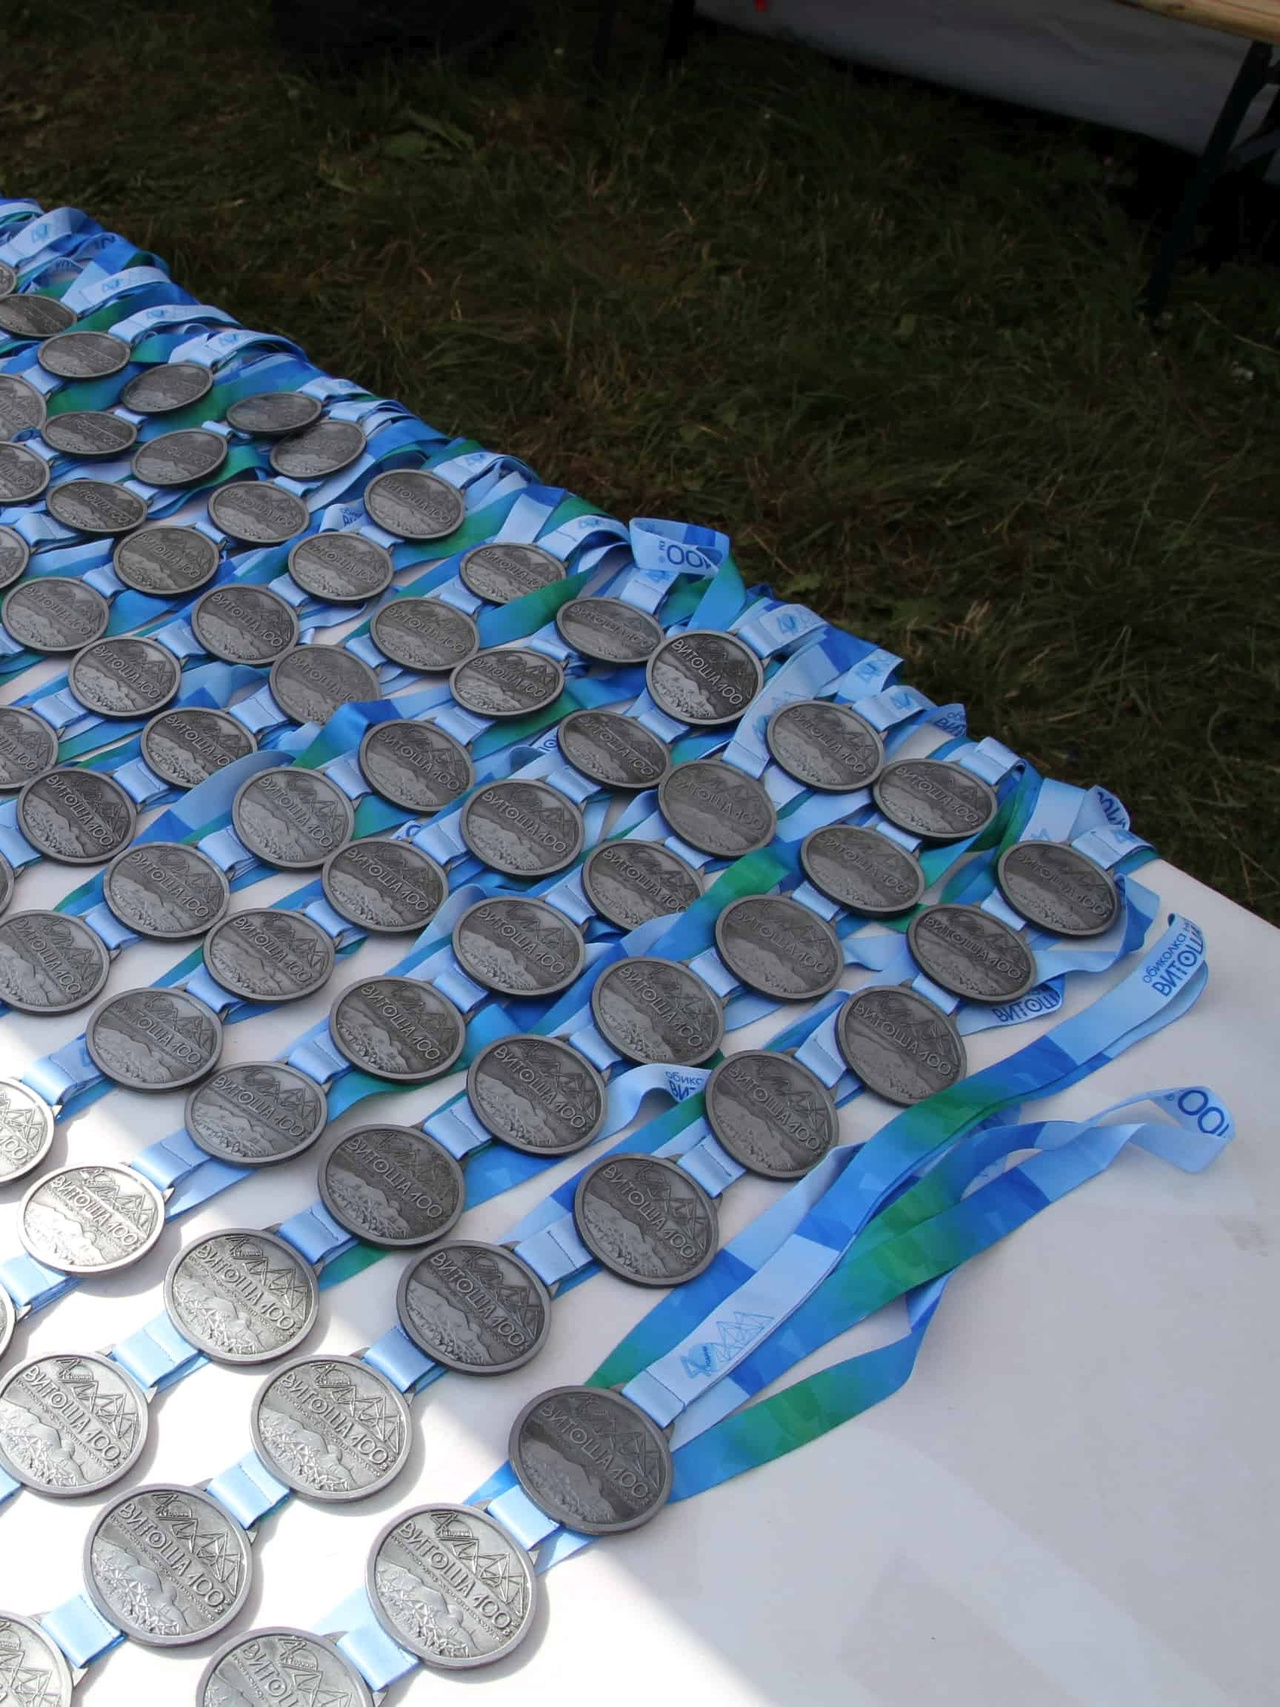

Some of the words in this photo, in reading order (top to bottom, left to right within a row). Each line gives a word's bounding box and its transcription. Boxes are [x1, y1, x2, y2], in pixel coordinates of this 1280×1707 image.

[669, 639, 721, 689] ВИТОША
[716, 684, 741, 704] 100
[165, 715, 212, 756] ВИТОША
[379, 728, 432, 772] ВИТОША
[47, 775, 93, 826] ВИТОША
[259, 776, 308, 825] ВИТОША
[481, 790, 538, 834] ВИТОША
[538, 830, 565, 853] 100
[896, 765, 951, 805] ВИТОША
[948, 803, 978, 823] 100
[131, 851, 182, 897] ВИТОША
[345, 849, 401, 892] ВИТОША
[399, 890, 428, 911] 100
[602, 849, 658, 895] ВИТОША
[15, 918, 60, 970] ВИТОША
[233, 916, 286, 962] ВИТОША
[285, 959, 310, 980] 100
[477, 906, 534, 953] ВИТОША
[534, 951, 564, 973] 100
[361, 984, 414, 1035] ВИТОША
[412, 1034, 438, 1060] 100
[619, 965, 675, 1023] ВИТОША
[672, 1020, 702, 1046] 100
[852, 1001, 918, 1053] ВИТОША
[919, 1049, 951, 1075] 100
[991, 993, 1060, 1022] ВИТОШ
[212, 1074, 273, 1118] ВИТОША
[272, 1116, 302, 1136] 100
[493, 1046, 556, 1104] ВИТОША
[553, 1102, 585, 1127] 100
[729, 1064, 787, 1128] ВИТОША
[785, 1121, 819, 1149] 100
[0, 1137, 28, 1161] 100
[346, 1138, 410, 1198] ВИТОША
[408, 1191, 441, 1217] 100
[52, 1175, 112, 1230] ВИТОША
[107, 1222, 137, 1245] 100
[603, 1167, 664, 1229] ВИТОША
[662, 1229, 694, 1258] 100
[194, 1244, 266, 1304] ВИТОША
[264, 1303, 294, 1331] 100
[431, 1252, 494, 1319] ВИТОША
[491, 1316, 524, 1345] 100
[20, 1363, 92, 1433] ВИТОША
[90, 1431, 120, 1461] 100
[281, 1373, 359, 1437] ВИТОША
[356, 1438, 390, 1466] 100
[541, 1405, 613, 1469] ВИТОША
[612, 1469, 648, 1498] 100
[120, 1503, 192, 1577] ВИТОША
[189, 1572, 226, 1608] 100
[398, 1521, 476, 1598] ВИТОША
[473, 1593, 512, 1629] 100
[243, 1640, 298, 1707] ВИТО
